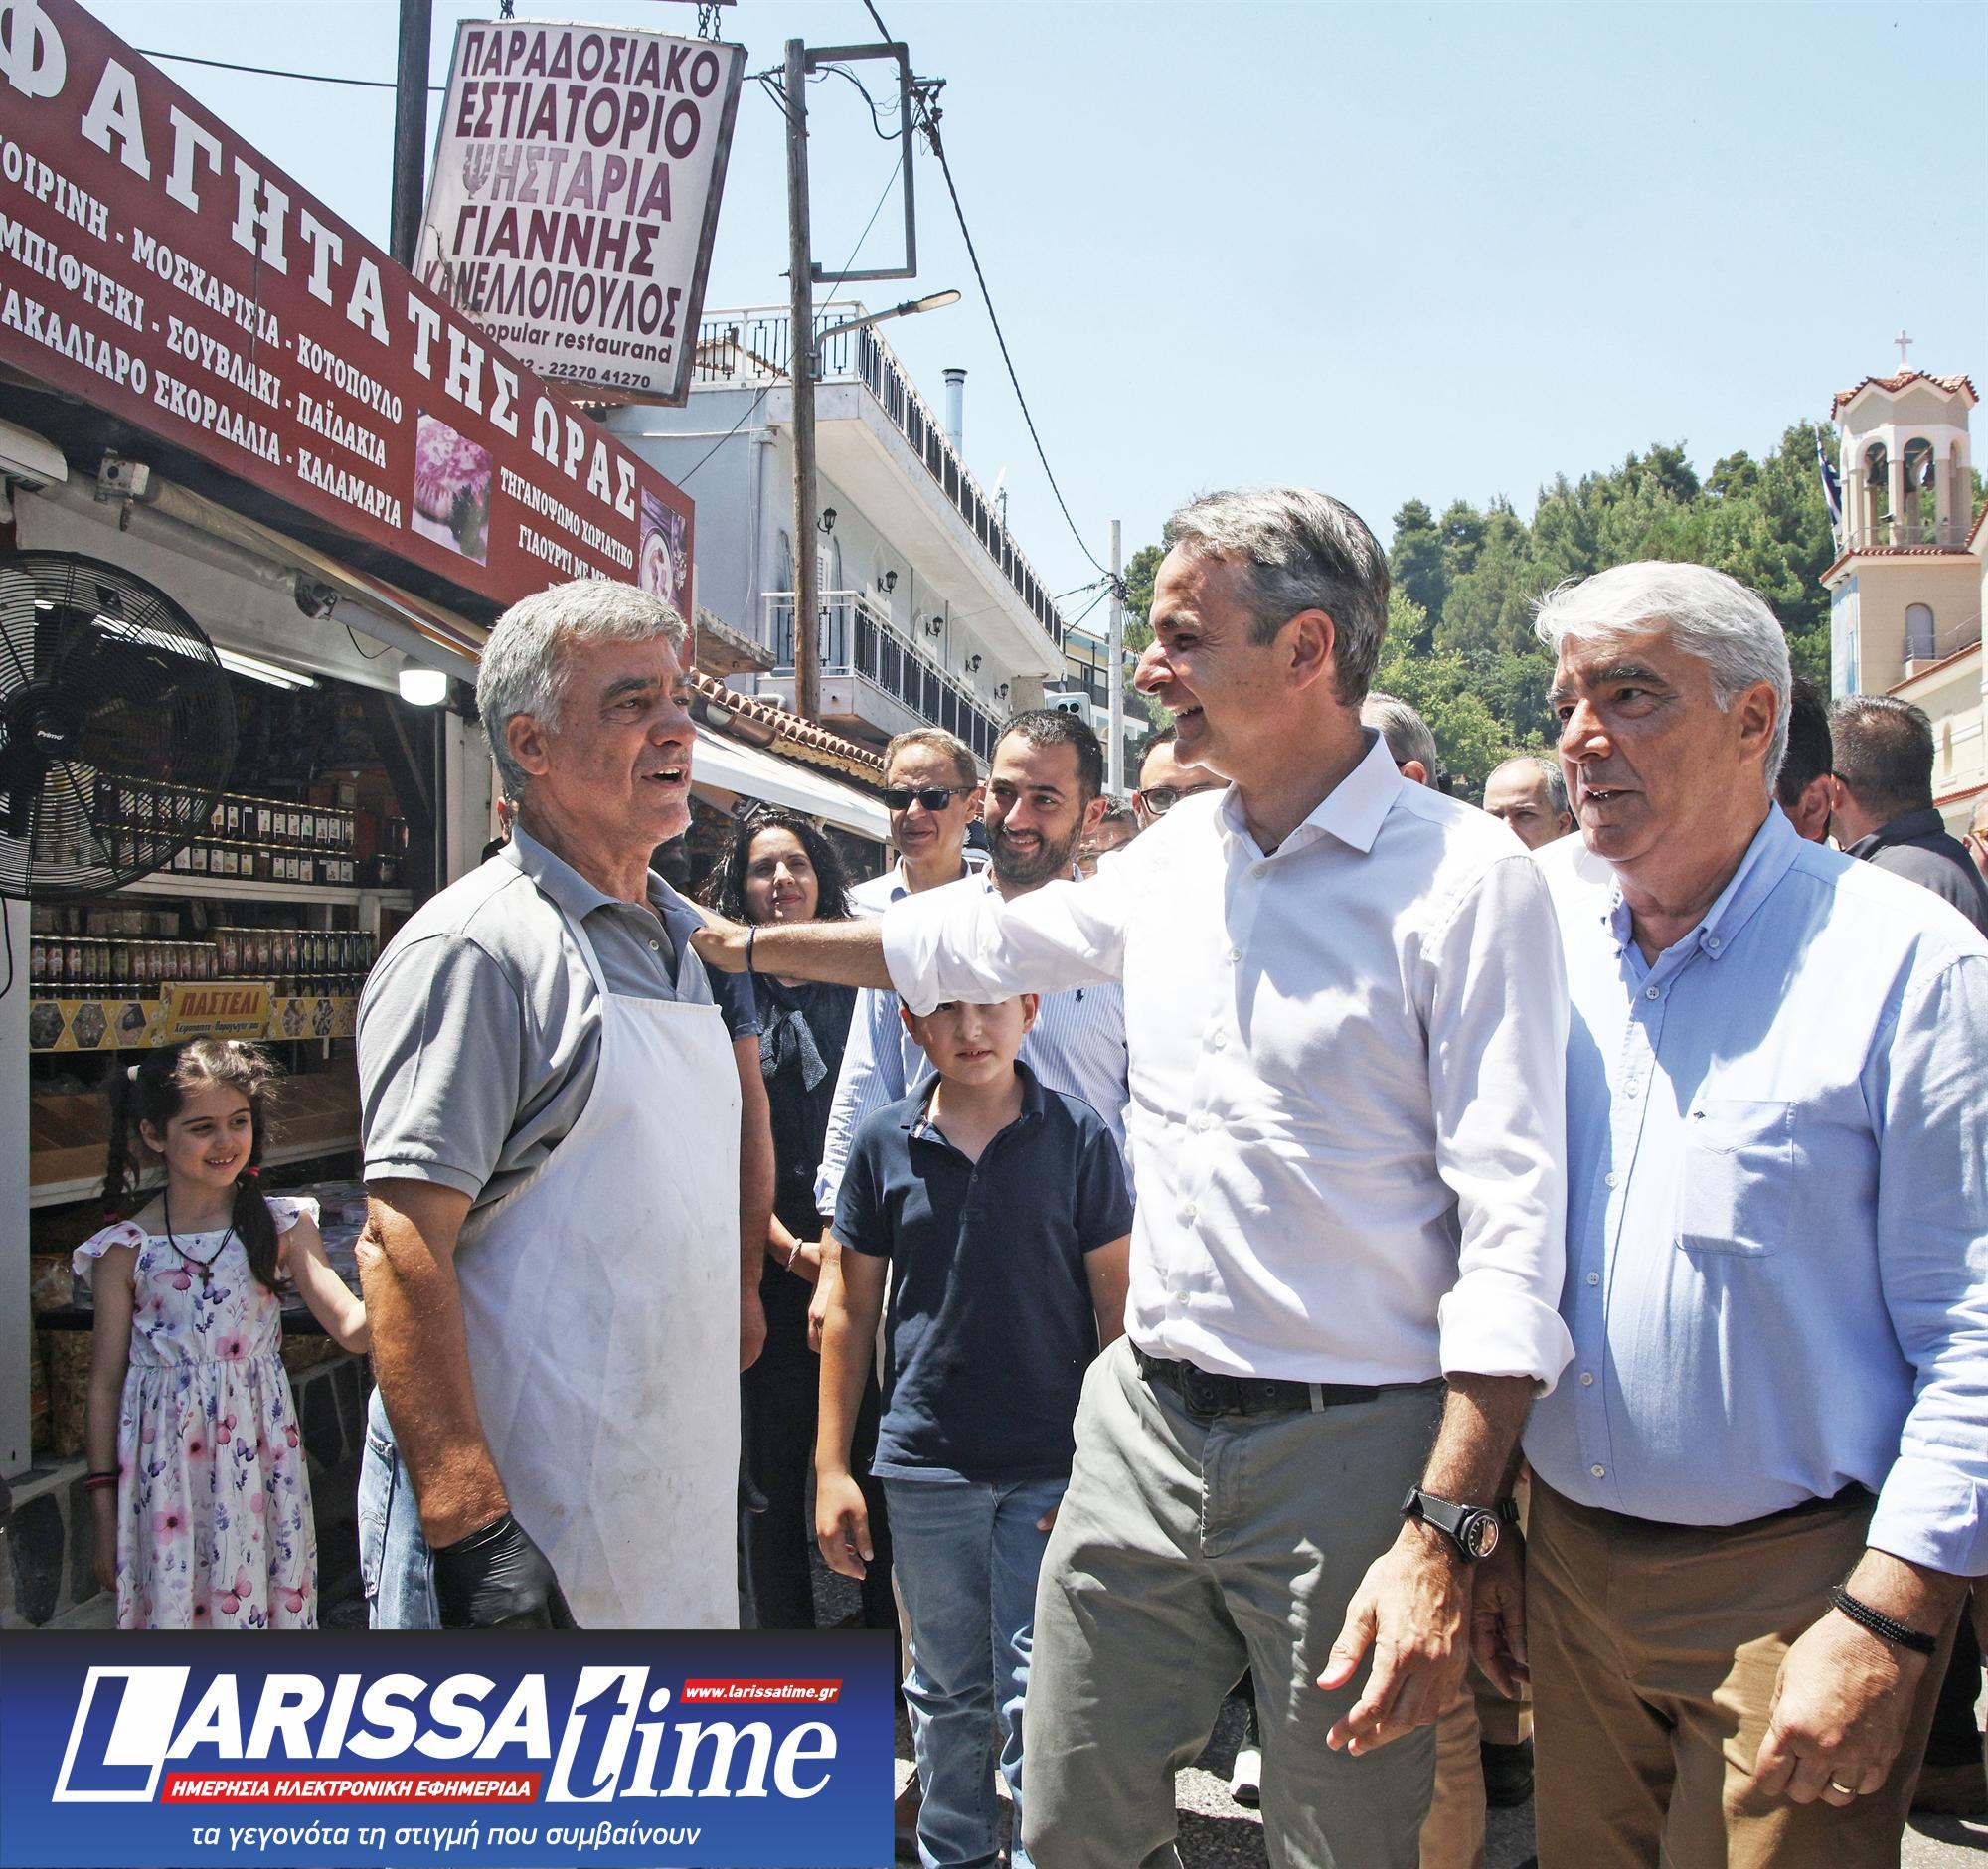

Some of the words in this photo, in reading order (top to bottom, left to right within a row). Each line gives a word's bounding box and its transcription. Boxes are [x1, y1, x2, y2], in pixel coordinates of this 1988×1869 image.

[461, 31, 720, 97] ΠΑΡΑΔΟΣΙΑΚΟ
[455, 82, 701, 159] ΕΣΤΙΑΤΟΡΙΟ
[462, 144, 671, 222] ΨΗΣΤΑΡΙΑ
[0, 0, 390, 347] ΦΑΓΗΤΑ
[408, 291, 520, 438] ΤΗΣ
[531, 397, 637, 522] ΩΡΑΣ
[452, 205, 660, 277] ΓΙΑΝΝΗΣ
[0, 135, 108, 243] ΟΙΡΙΝΗ
[132, 227, 279, 349] ΜΟΣΧΑΡΙΣΙΑ
[297, 333, 402, 425] ΚΟΤΟΠΟΥΛΟ
[0, 212, 144, 332] ΜΠΙΦΤΕΚΙ
[166, 314, 281, 410] ΣΟΥΒΛΑΚΙ
[297, 392, 386, 469] ΠΑΪΔΑΚΙΑ
[549, 362, 596, 380] 22270
[601, 369, 651, 389] 41270
[555, 331, 672, 364] restaurand
[0, 282, 147, 395] ΑΚΑΛΙΑΡΟ
[154, 369, 281, 466] ΣΚΟΡΔΑΛΙΑ
[298, 447, 402, 529] ΚΑΛΑΜΑΡΙΑ
[500, 466, 580, 537] ΤΗΓΑΝΟΨΩΜΟ
[581, 519, 633, 571] ΧΩΡΙΑΤΙΚΟ
[518, 524, 573, 575] ΓΙΑΟΥΡΤΙ
[179, 992, 260, 1016] ΠΑΣΤΕΛΙ
